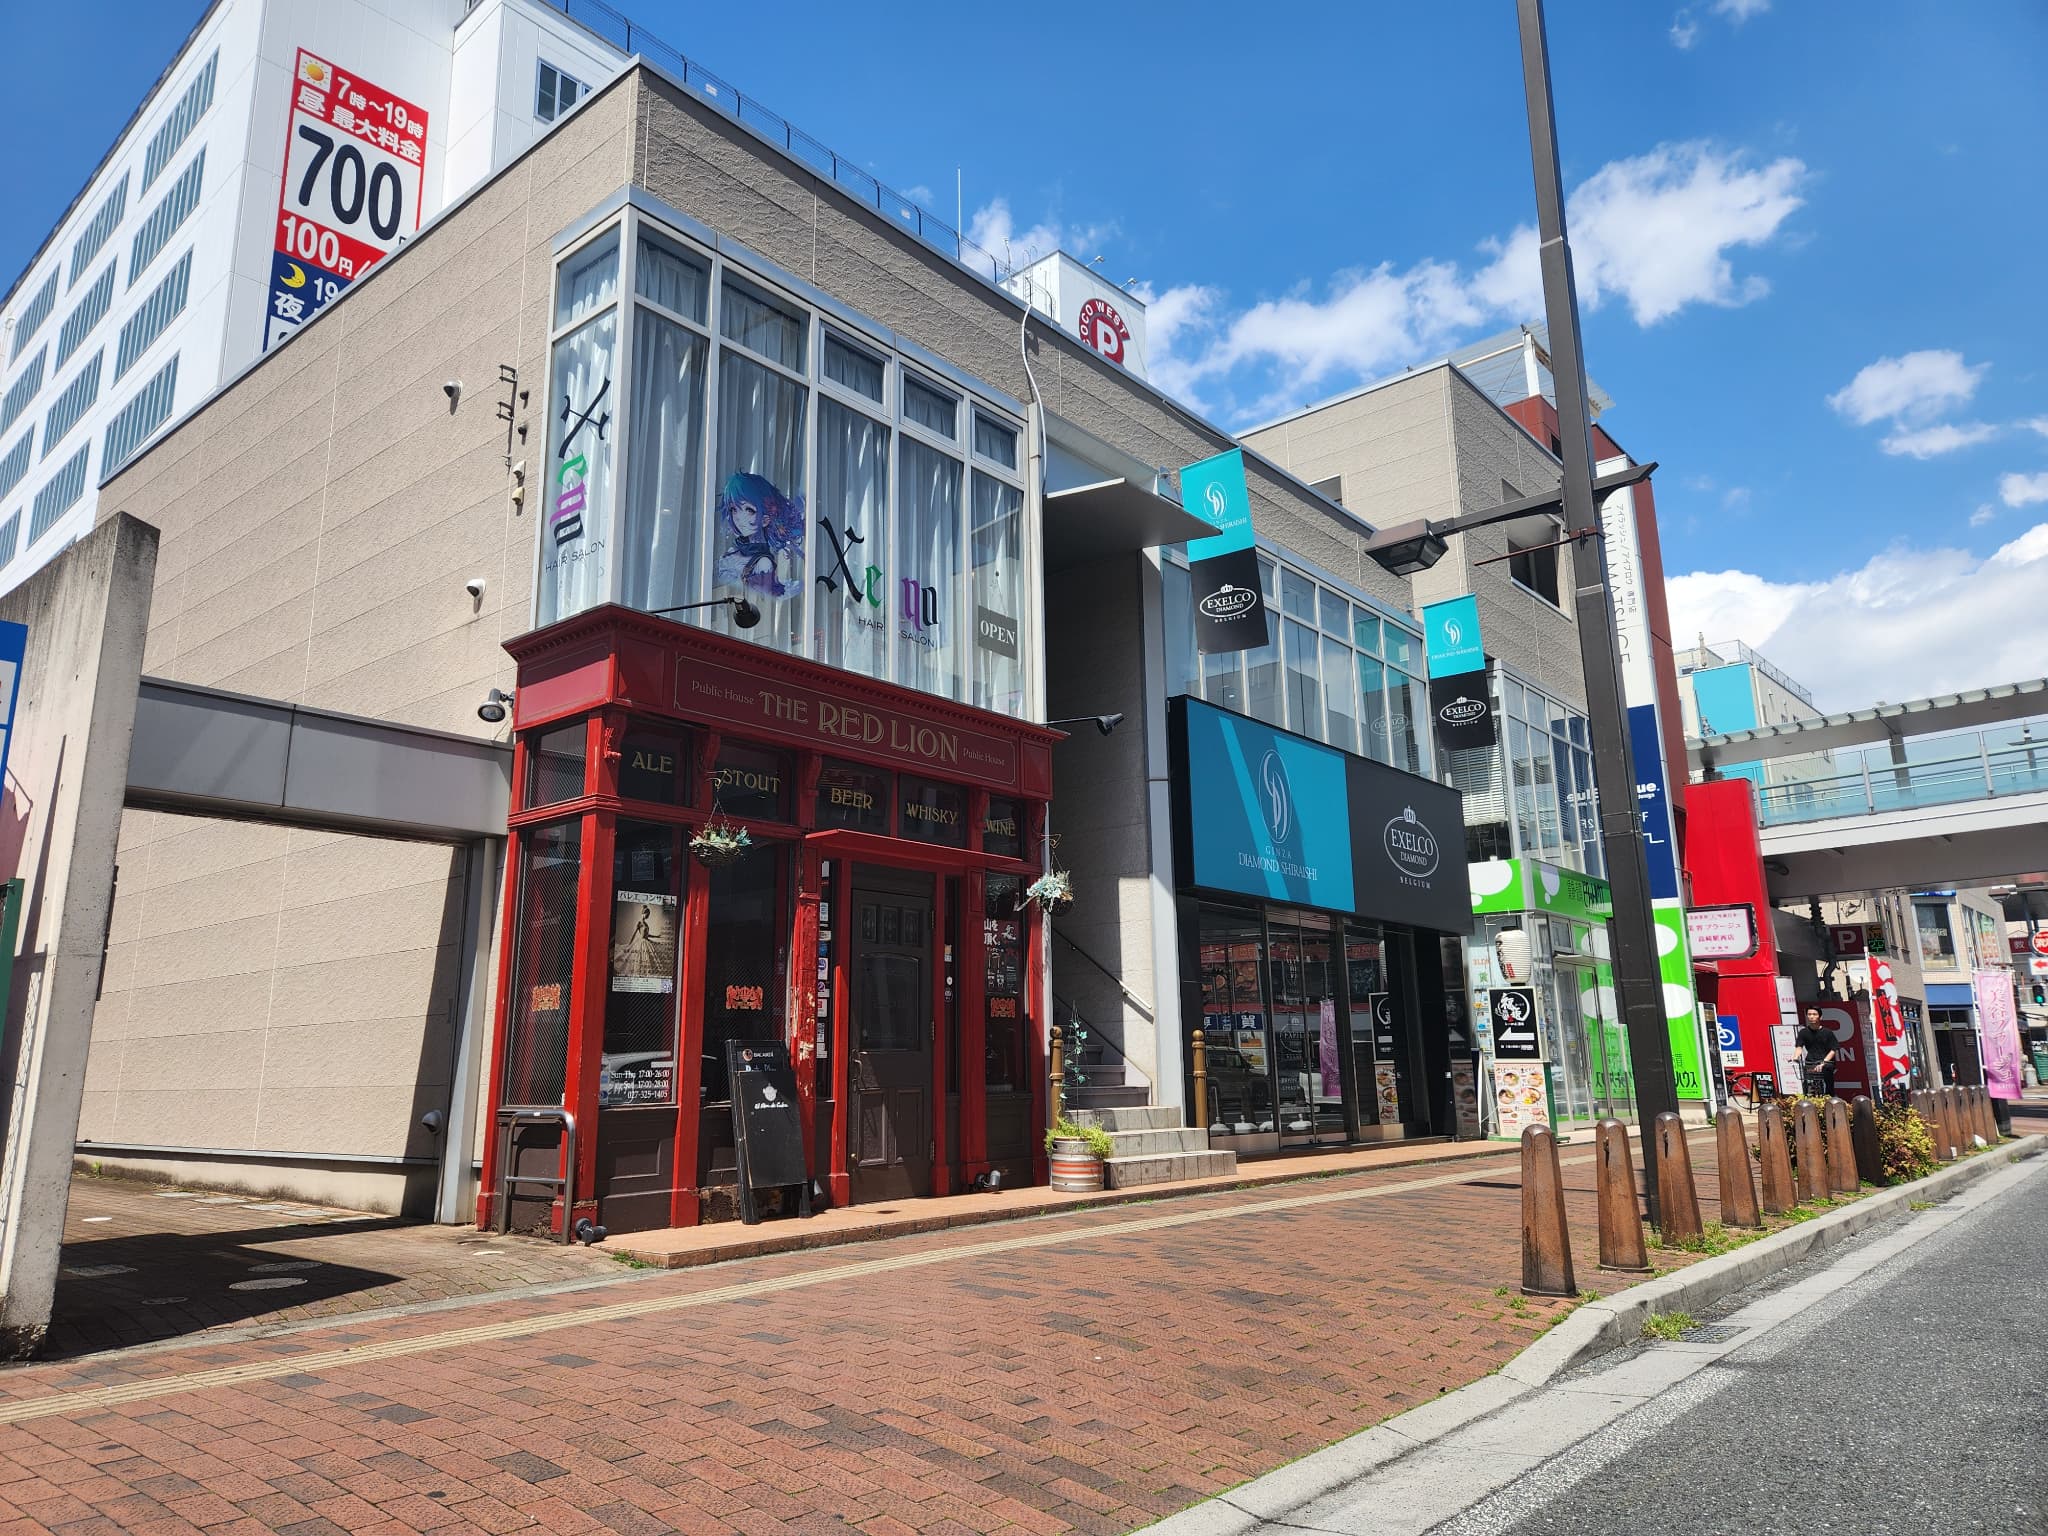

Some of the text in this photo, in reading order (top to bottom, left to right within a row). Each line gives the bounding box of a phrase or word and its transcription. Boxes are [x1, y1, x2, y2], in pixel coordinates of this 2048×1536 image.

[297, 85, 422, 164] 昼 最大料金
[298, 124, 407, 246] 700
[274, 290, 305, 322] 夜
[1095, 300, 1127, 333] WEST
[1096, 318, 1119, 355] P
[545, 538, 606, 574] HAIR SALON
[1206, 592, 1251, 609] EXELCO
[1216, 603, 1244, 613] DIAMOND
[858, 615, 936, 648] HAIR SALON
[980, 618, 1015, 647] OPEN
[691, 679, 1006, 767] Public House THE RED LION Public House
[1446, 703, 1482, 717] EXELCO
[631, 750, 673, 775] ALE
[722, 767, 782, 795] STOUT
[830, 786, 874, 811] BEER
[905, 801, 959, 826] WHISKY
[984, 817, 1017, 838] WINE
[1265, 846, 1292, 859] GINZA
[1391, 828, 1433, 856] EXELCO
[1238, 852, 1318, 880] DIAMOND SHIRAISHI
[1400, 851, 1428, 866] DIAMOND
[1400, 876, 1431, 889] BELGIUM
[1838, 930, 1857, 951] P
